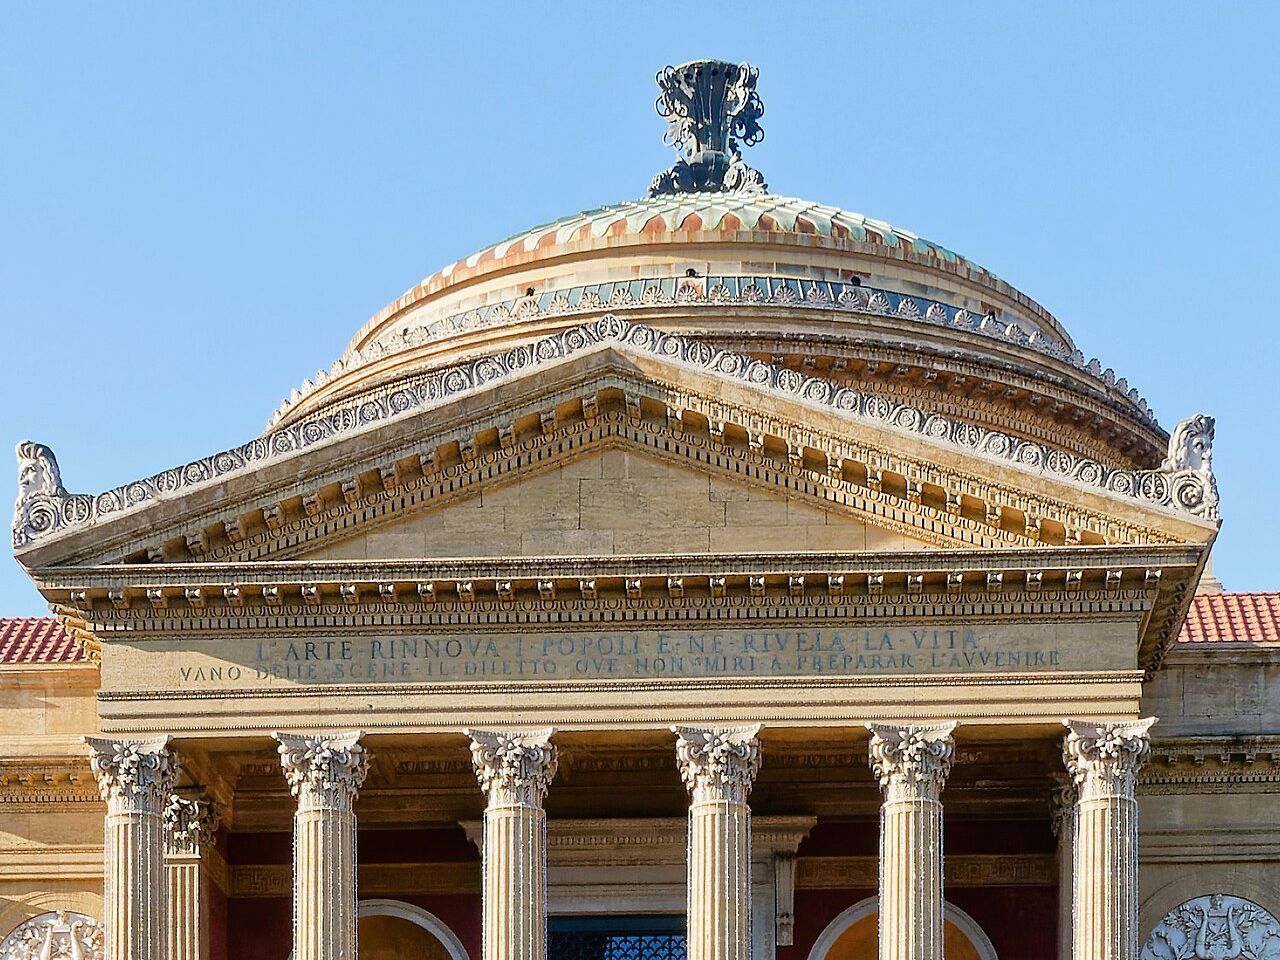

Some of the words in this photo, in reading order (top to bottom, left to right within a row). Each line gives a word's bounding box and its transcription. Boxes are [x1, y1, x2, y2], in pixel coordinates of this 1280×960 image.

[257, 641, 354, 661] L'ARTE
[371, 638, 500, 660] RINNOVA
[516, 638, 525, 657] I
[542, 635, 640, 656] POPOLI
[658, 634, 673, 654] E
[688, 634, 725, 654] NE
[743, 632, 846, 652] RIVELA
[863, 631, 897, 651] LA
[913, 629, 978, 650] VITA
[179, 666, 242, 681] VANO
[335, 662, 410, 680] SCENE
[426, 661, 450, 677] IL
[464, 659, 557, 677] DILETTO
[575, 657, 618, 674] OVE
[635, 657, 684, 674] NON
[704, 656, 755, 673] MIRI
[770, 656, 783, 670] A
[797, 653, 915, 672] PREPARAR
[931, 650, 1060, 669] L'AVVENIRE
